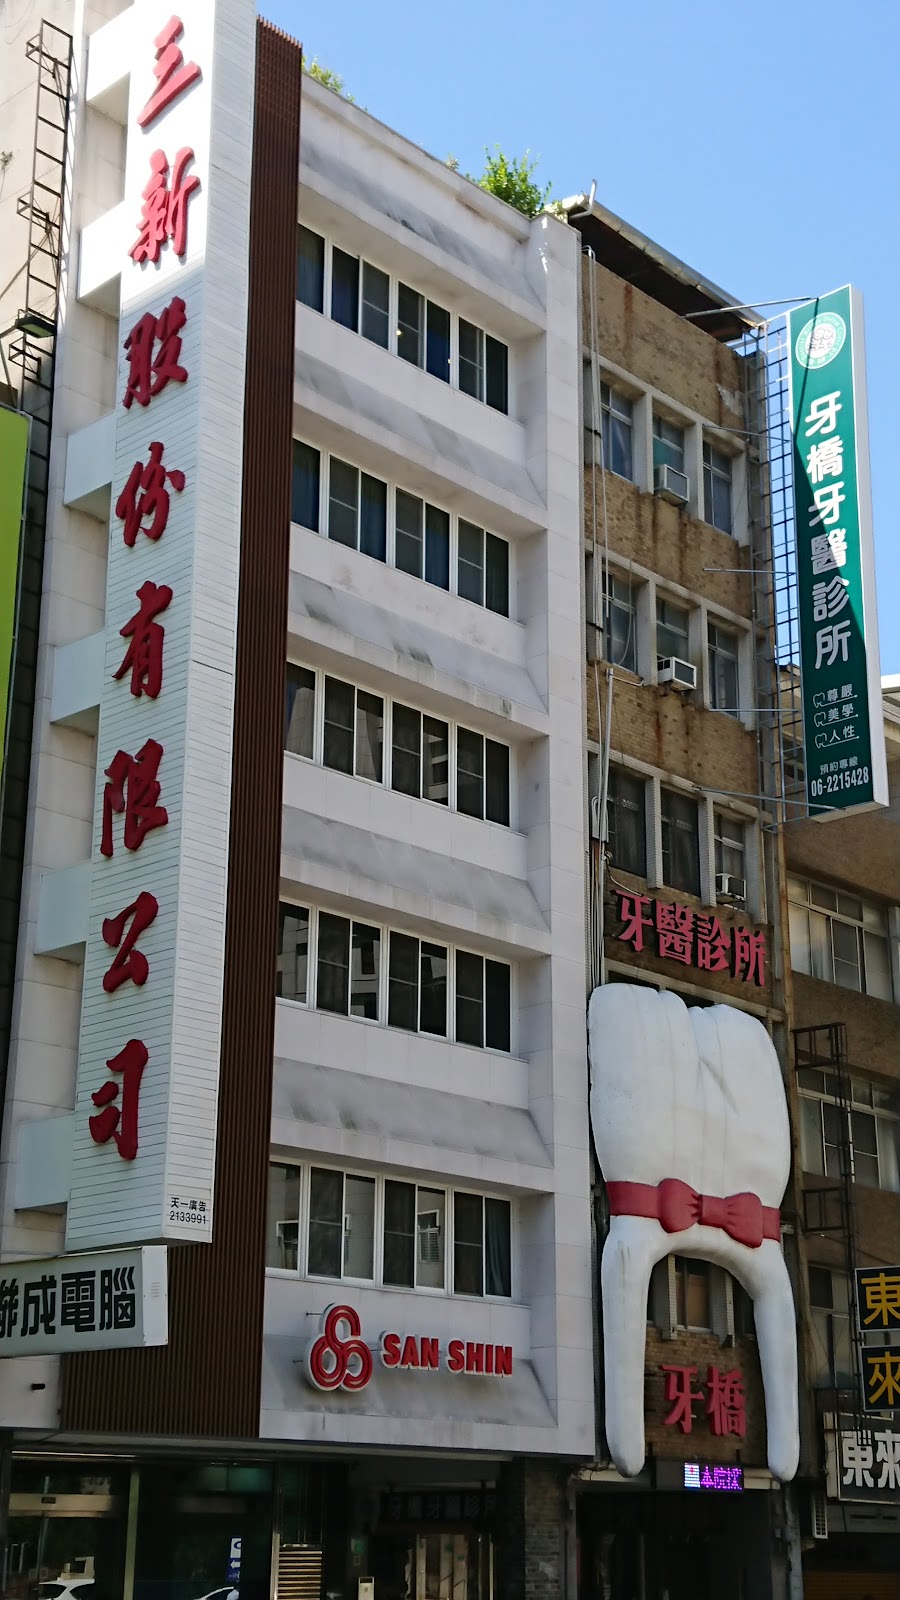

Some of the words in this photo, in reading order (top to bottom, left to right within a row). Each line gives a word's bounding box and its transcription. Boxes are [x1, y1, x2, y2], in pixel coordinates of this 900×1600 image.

[805, 390, 852, 669] 牙橋牙醫診所
[88, 14, 202, 1161] 三新股份有限公司
[828, 703, 854, 721] 美學
[829, 725, 855, 743] 人性
[820, 756, 858, 775] 預約專線
[811, 766, 869, 797] 06-2215428
[612, 889, 767, 986] 牙醫診所
[170, 1210, 206, 1224] 2133991
[171, 1197, 206, 1212] 天一廣告
[382, 1332, 439, 1370] SAN
[448, 1339, 513, 1377] SHIN
[658, 1364, 746, 1438] 牙橋
